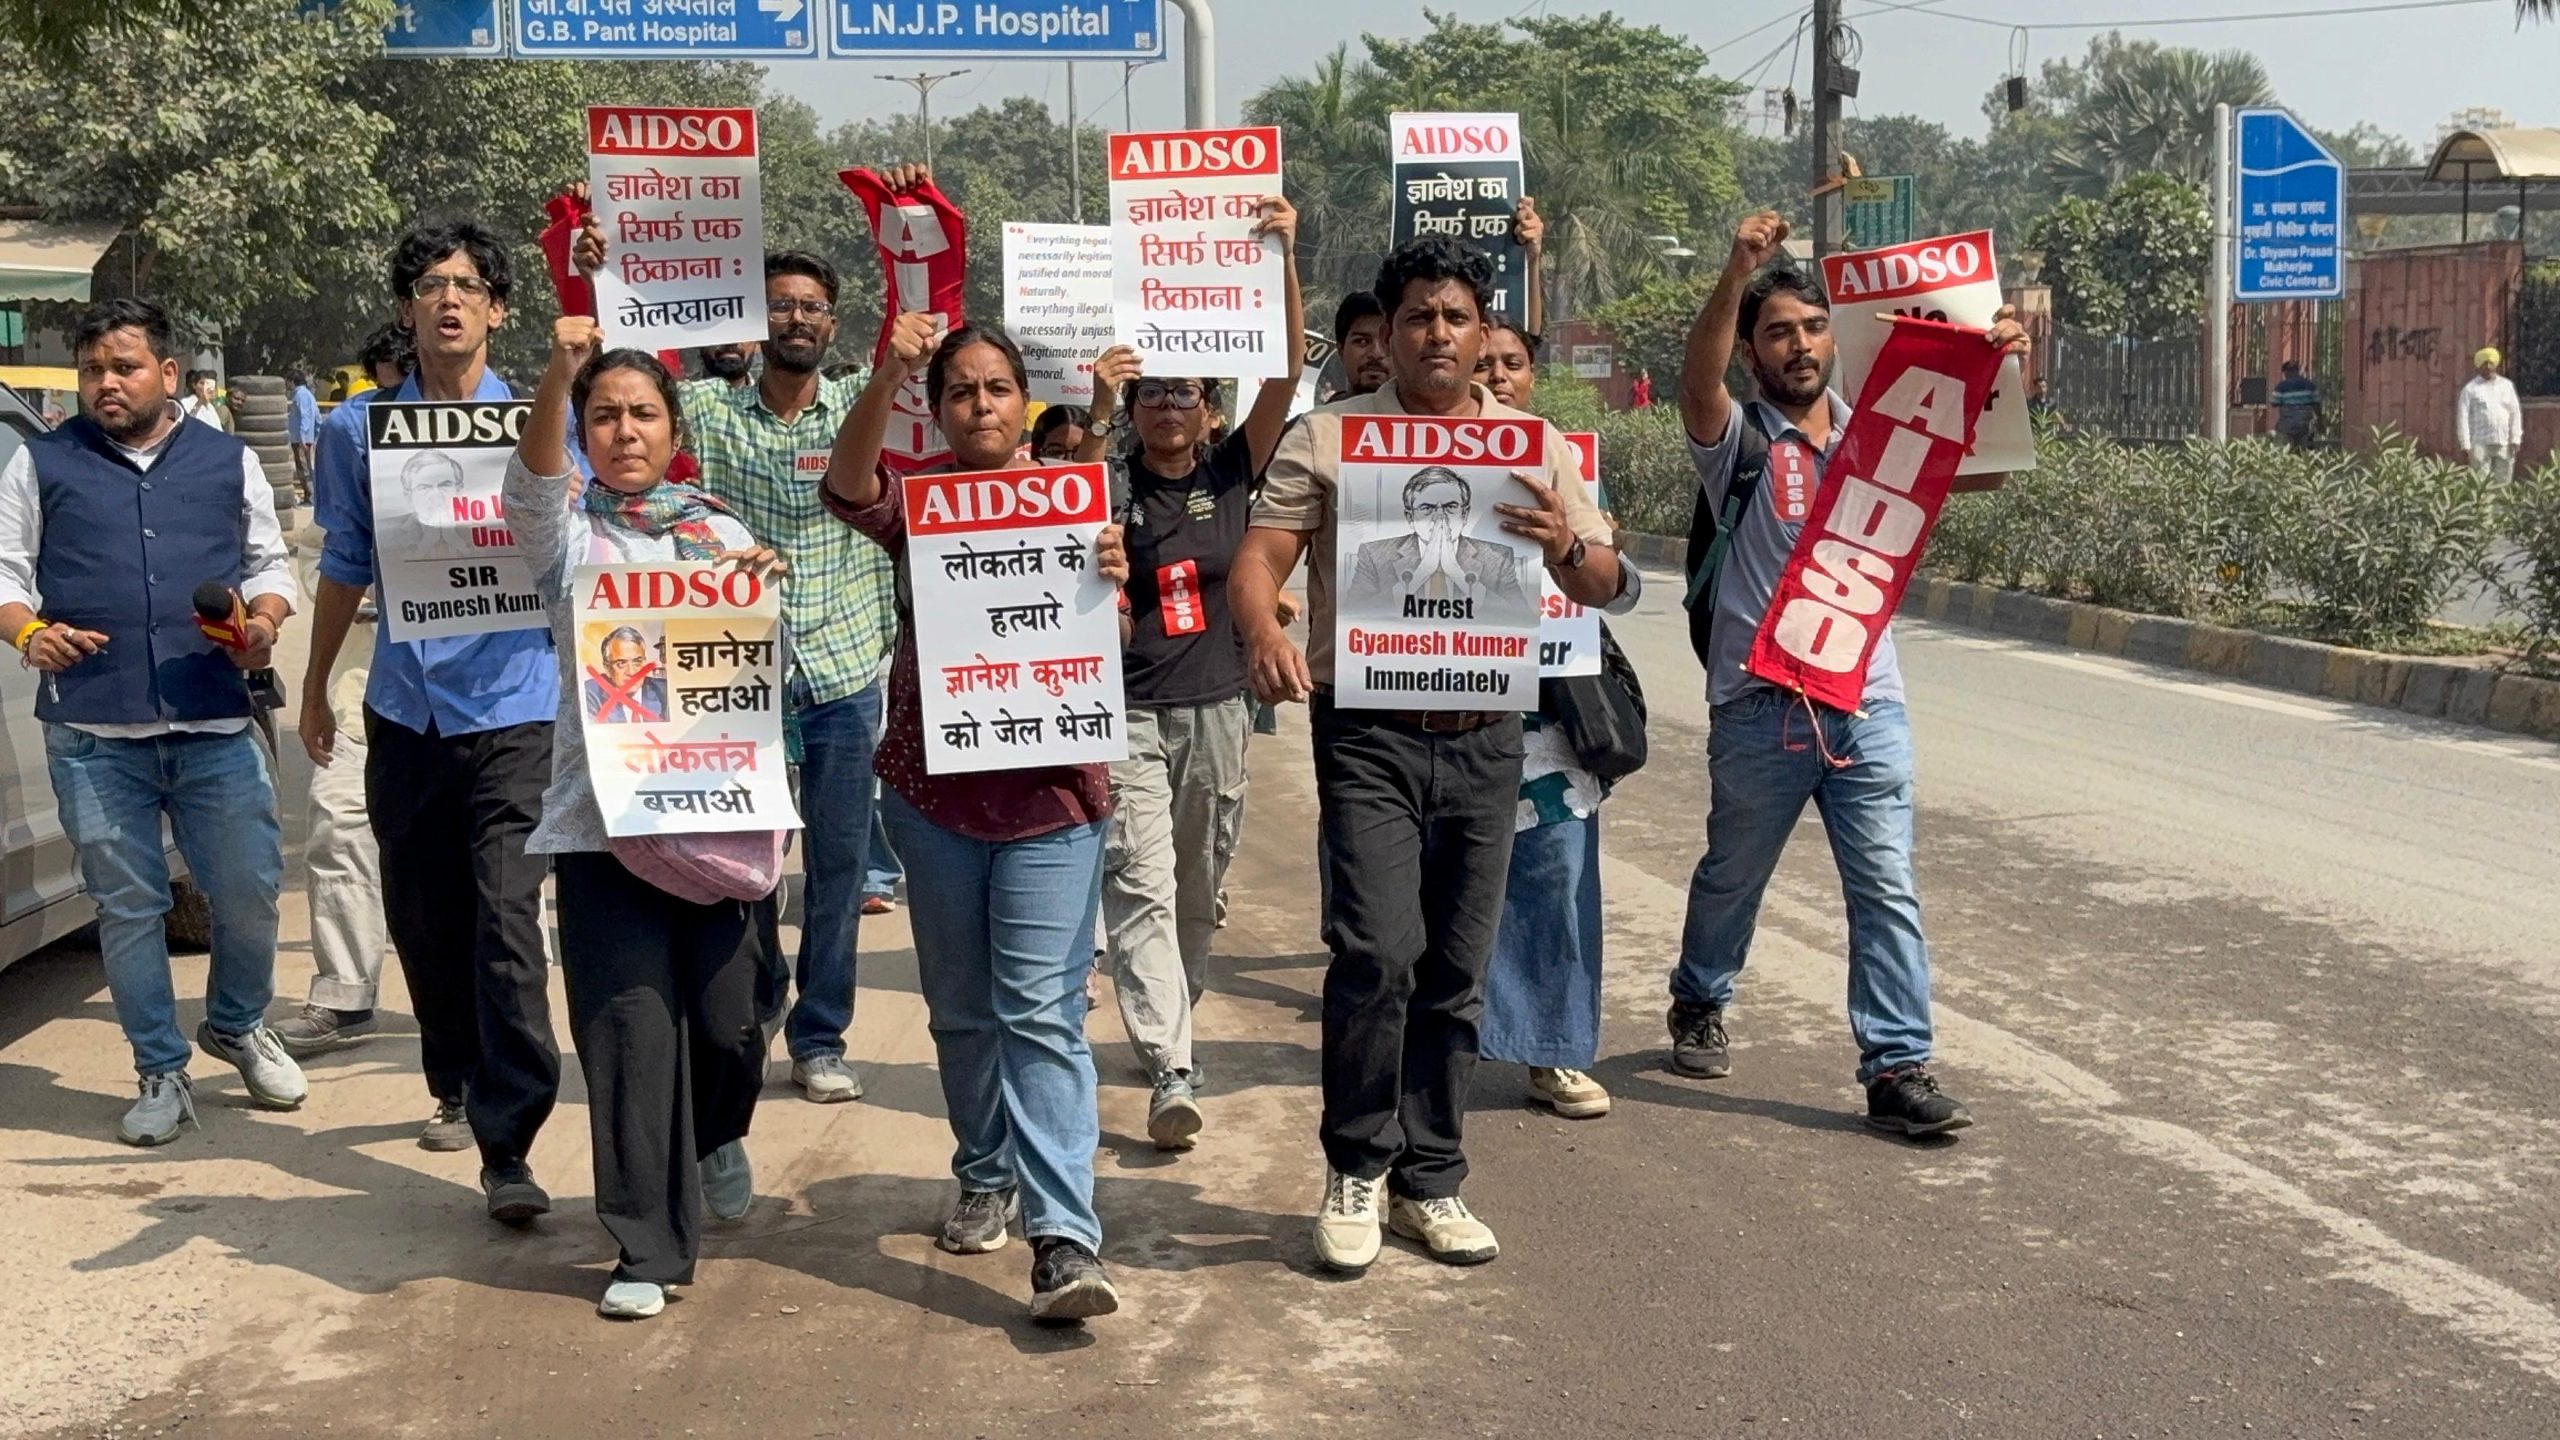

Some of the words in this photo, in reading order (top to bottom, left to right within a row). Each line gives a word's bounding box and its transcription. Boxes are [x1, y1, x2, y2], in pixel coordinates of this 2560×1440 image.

[527, 20, 577, 42] G.B.
[584, 21, 637, 42] Pant
[642, 20, 737, 46] Hospital
[842, 4, 963, 35] L.N.J.P.
[975, 4, 1109, 42] Hospital
[598, 115, 742, 151] AIDSO
[1402, 126, 1508, 155] AIDSO
[1120, 135, 1266, 175] AIDSO
[606, 167, 692, 201] ज्ञानेश
[701, 174, 741, 200] का
[1406, 173, 1474, 204] ज्ञानेश
[1478, 178, 1508, 199] का
[1127, 188, 1215, 227] ज्ञानेश
[618, 211, 683, 243] सिर्फ
[692, 218, 742, 243] एक
[1083, 236, 1107, 247] legal
[1470, 215, 1510, 238] एक
[1018, 251, 1075, 263] necessarily
[1077, 252, 1112, 263] legitim
[1139, 231, 1204, 267] सिर्फ
[1214, 237, 1263, 267] एक
[2244, 247, 2257, 259] Dr.
[2260, 246, 2298, 260] Shyama
[2300, 246, 2333, 258] Prasad
[621, 253, 721, 285] ठिकाना
[1018, 267, 1060, 280] justified
[1062, 267, 1080, 278] and
[1838, 241, 1980, 297] AIDSO
[2259, 275, 2283, 288] Civic
[2285, 275, 2317, 287] Centre
[2264, 261, 2313, 274] Mukherjee
[1020, 303, 1074, 317] everything
[1077, 302, 1107, 317] illegal
[1141, 277, 1242, 312] ठिकाना
[619, 296, 745, 328] जेलखाना
[1020, 323, 1077, 339] necessarily
[1081, 324, 1115, 339] unjusti
[1137, 322, 1264, 353] जेलखाना
[1080, 345, 1100, 358] and
[1026, 367, 1066, 380] mmoral.
[1351, 422, 1529, 461] AIDSO
[797, 456, 828, 470] AIDS
[1784, 446, 1805, 516] AIDSO
[452, 496, 486, 521] No
[918, 473, 1092, 525] AIDSO
[1774, 365, 1966, 674] AIDSO
[941, 540, 1046, 581] लोकतंत्र
[1055, 533, 1087, 572] के
[449, 566, 499, 589] SIR
[587, 569, 761, 611] AIDSO
[402, 595, 490, 623] Gyanesh
[495, 593, 545, 615] Kum
[1170, 565, 1194, 630] AIDSO
[1402, 594, 1474, 620] Arrest
[986, 592, 1064, 638] हत्यारे
[672, 630, 774, 671] ज्ञानेश
[1348, 628, 1446, 656] Gyanesh
[1452, 631, 1528, 658] Kumar
[941, 653, 1021, 698] ज्ञानेश
[1028, 656, 1105, 697] कुमार
[1365, 665, 1510, 696] Immediately
[677, 674, 772, 717] हटाओ
[940, 711, 982, 751] को
[991, 708, 1044, 746] जेल
[1056, 701, 1114, 741] भेजो
[617, 730, 758, 775] लोकतंत्र
[635, 782, 755, 815] बचाओ
